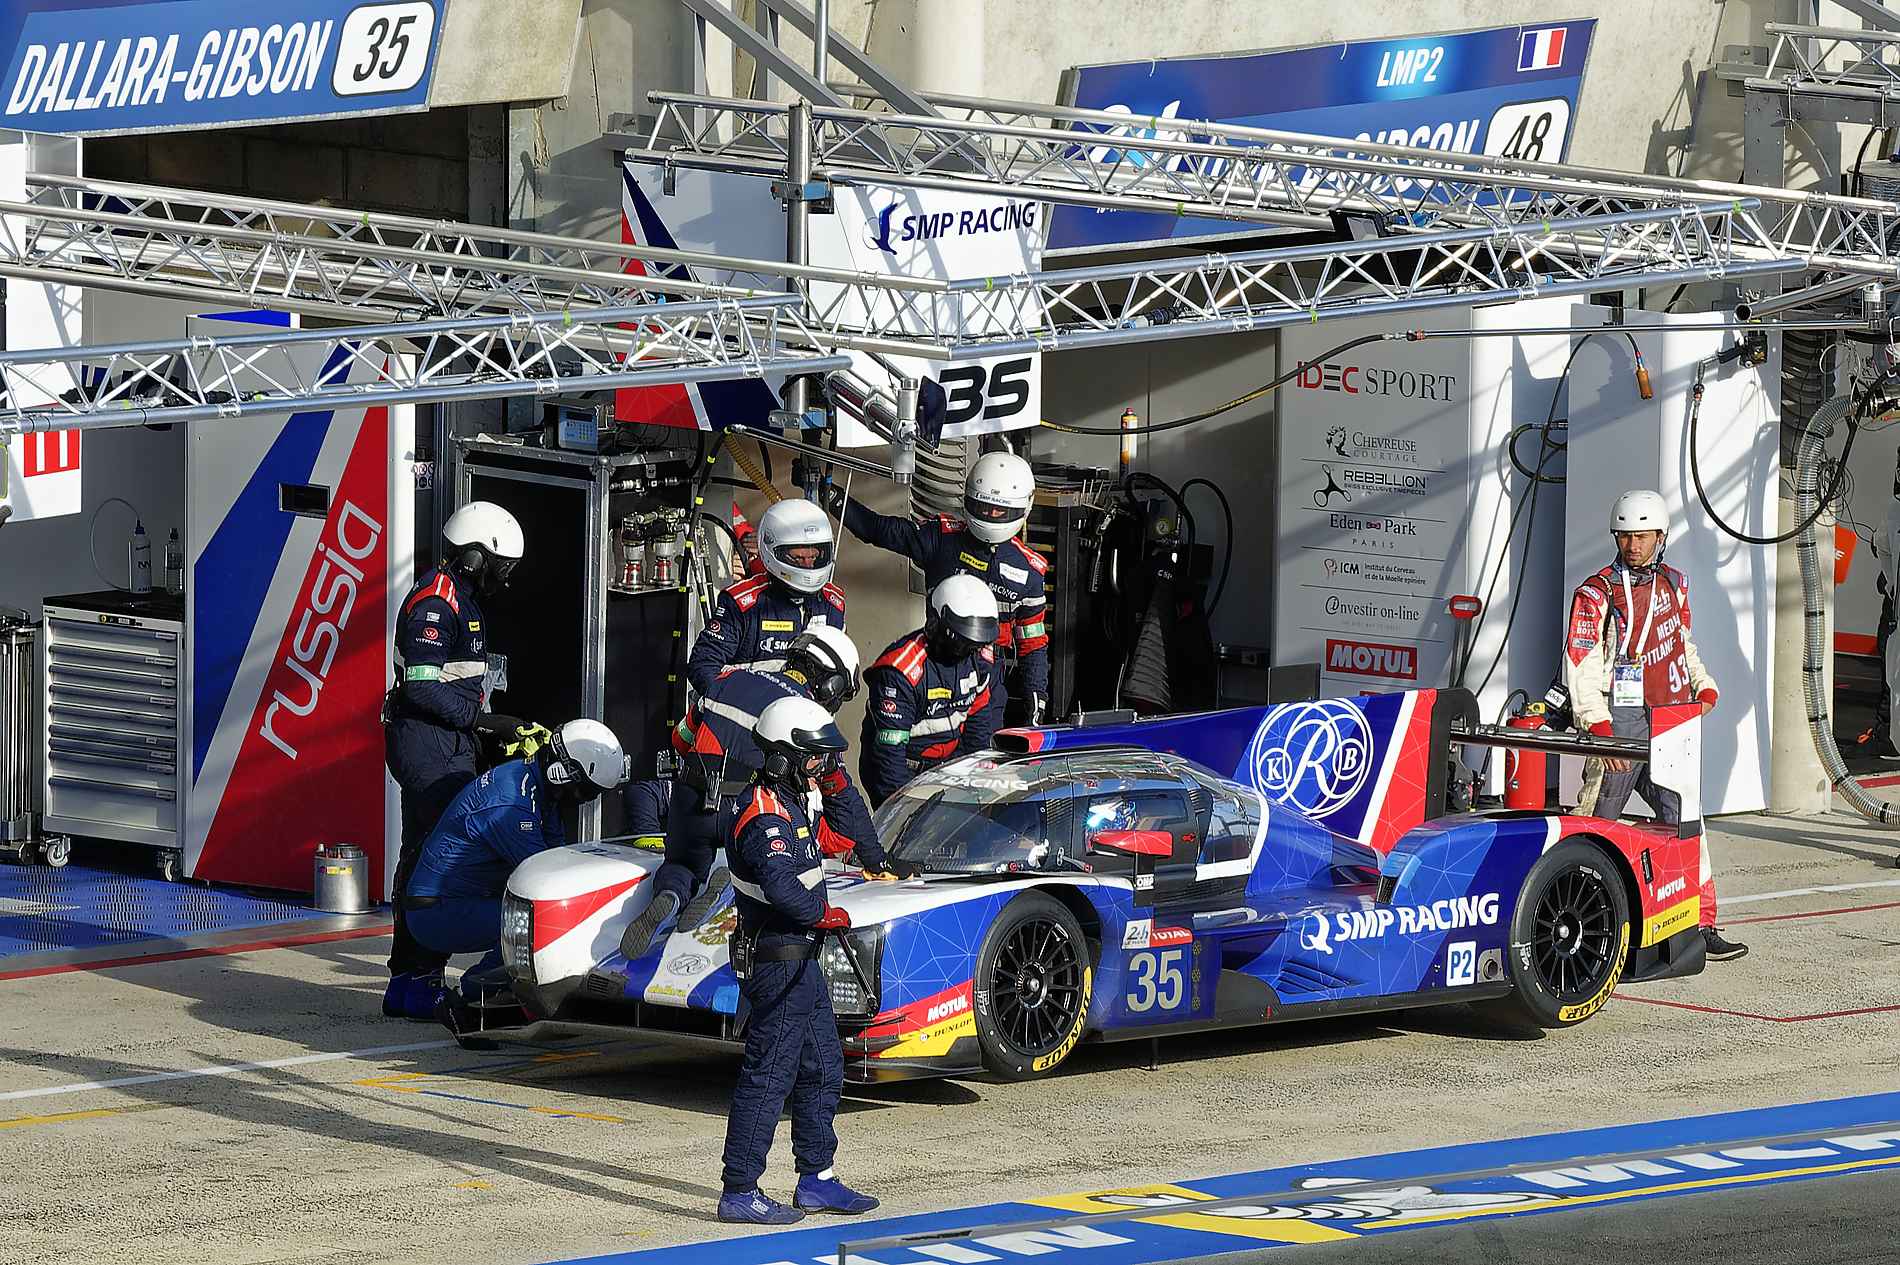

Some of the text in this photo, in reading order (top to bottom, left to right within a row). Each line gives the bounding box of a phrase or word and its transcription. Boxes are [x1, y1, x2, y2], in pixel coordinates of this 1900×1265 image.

[352, 15, 417, 82] 35
[5, 20, 334, 116] DALLARA-GIBSON
[1377, 46, 1444, 88] LMP2
[902, 201, 1035, 242] SMP RACING
[939, 357, 1032, 424] 35
[1296, 360, 1456, 402] IDEC SPORT
[1344, 470, 1426, 488] REBELLION
[1330, 513, 1417, 536] Eden Park
[1352, 538, 1395, 549] PARIS
[1340, 562, 1360, 574] ICM
[1380, 605, 1421, 621] on-line
[259, 499, 384, 761] russia
[1330, 644, 1414, 675] MOTUL
[1668, 654, 1690, 693] 93
[1656, 876, 1687, 902] MOTUL
[1334, 893, 1499, 942] SMP RACING
[1661, 910, 1690, 928] DUNLOP
[1152, 929, 1191, 941] TOTAL
[1450, 950, 1473, 980] P2
[1127, 949, 1182, 1012] 35
[927, 994, 968, 1023] MOTUL
[934, 1018, 972, 1038] DUNLOP
